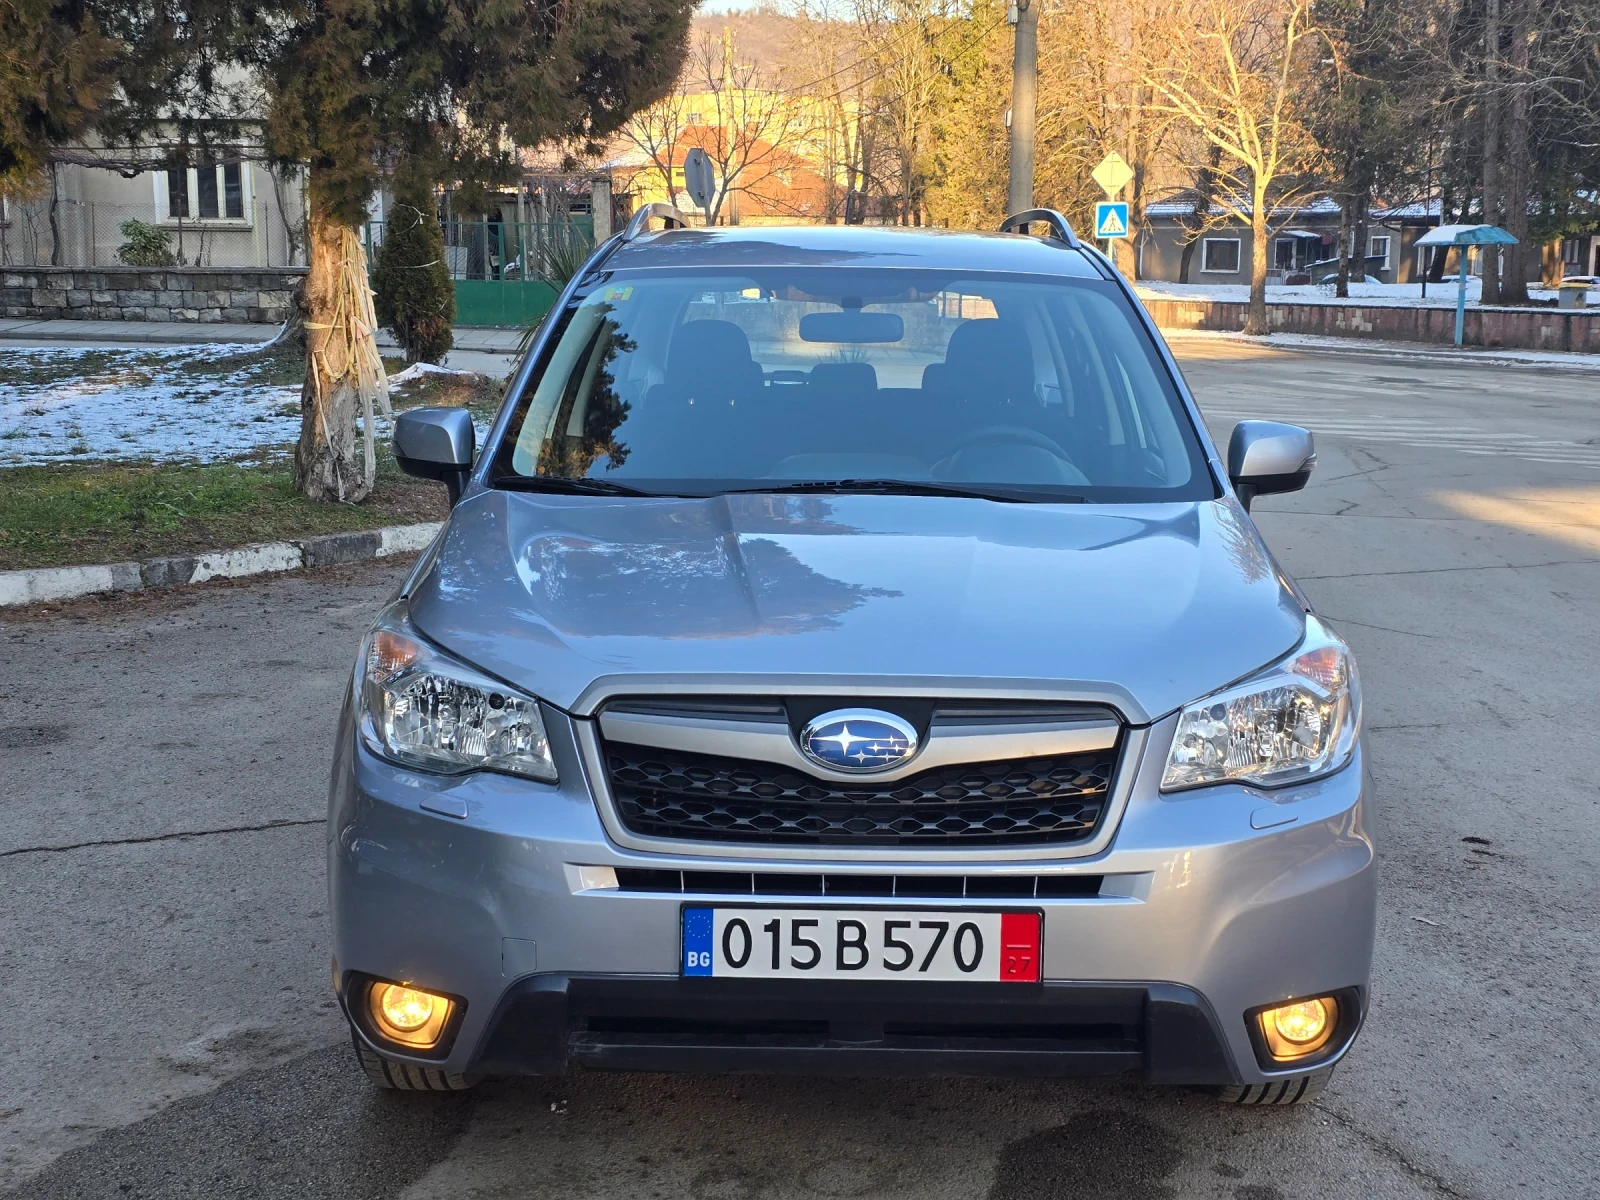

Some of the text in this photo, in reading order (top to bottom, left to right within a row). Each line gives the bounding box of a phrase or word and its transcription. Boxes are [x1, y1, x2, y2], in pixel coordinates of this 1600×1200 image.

[722, 918, 984, 972] 015B570
[687, 951, 711, 967] BG
[1006, 955, 1032, 974] 27
